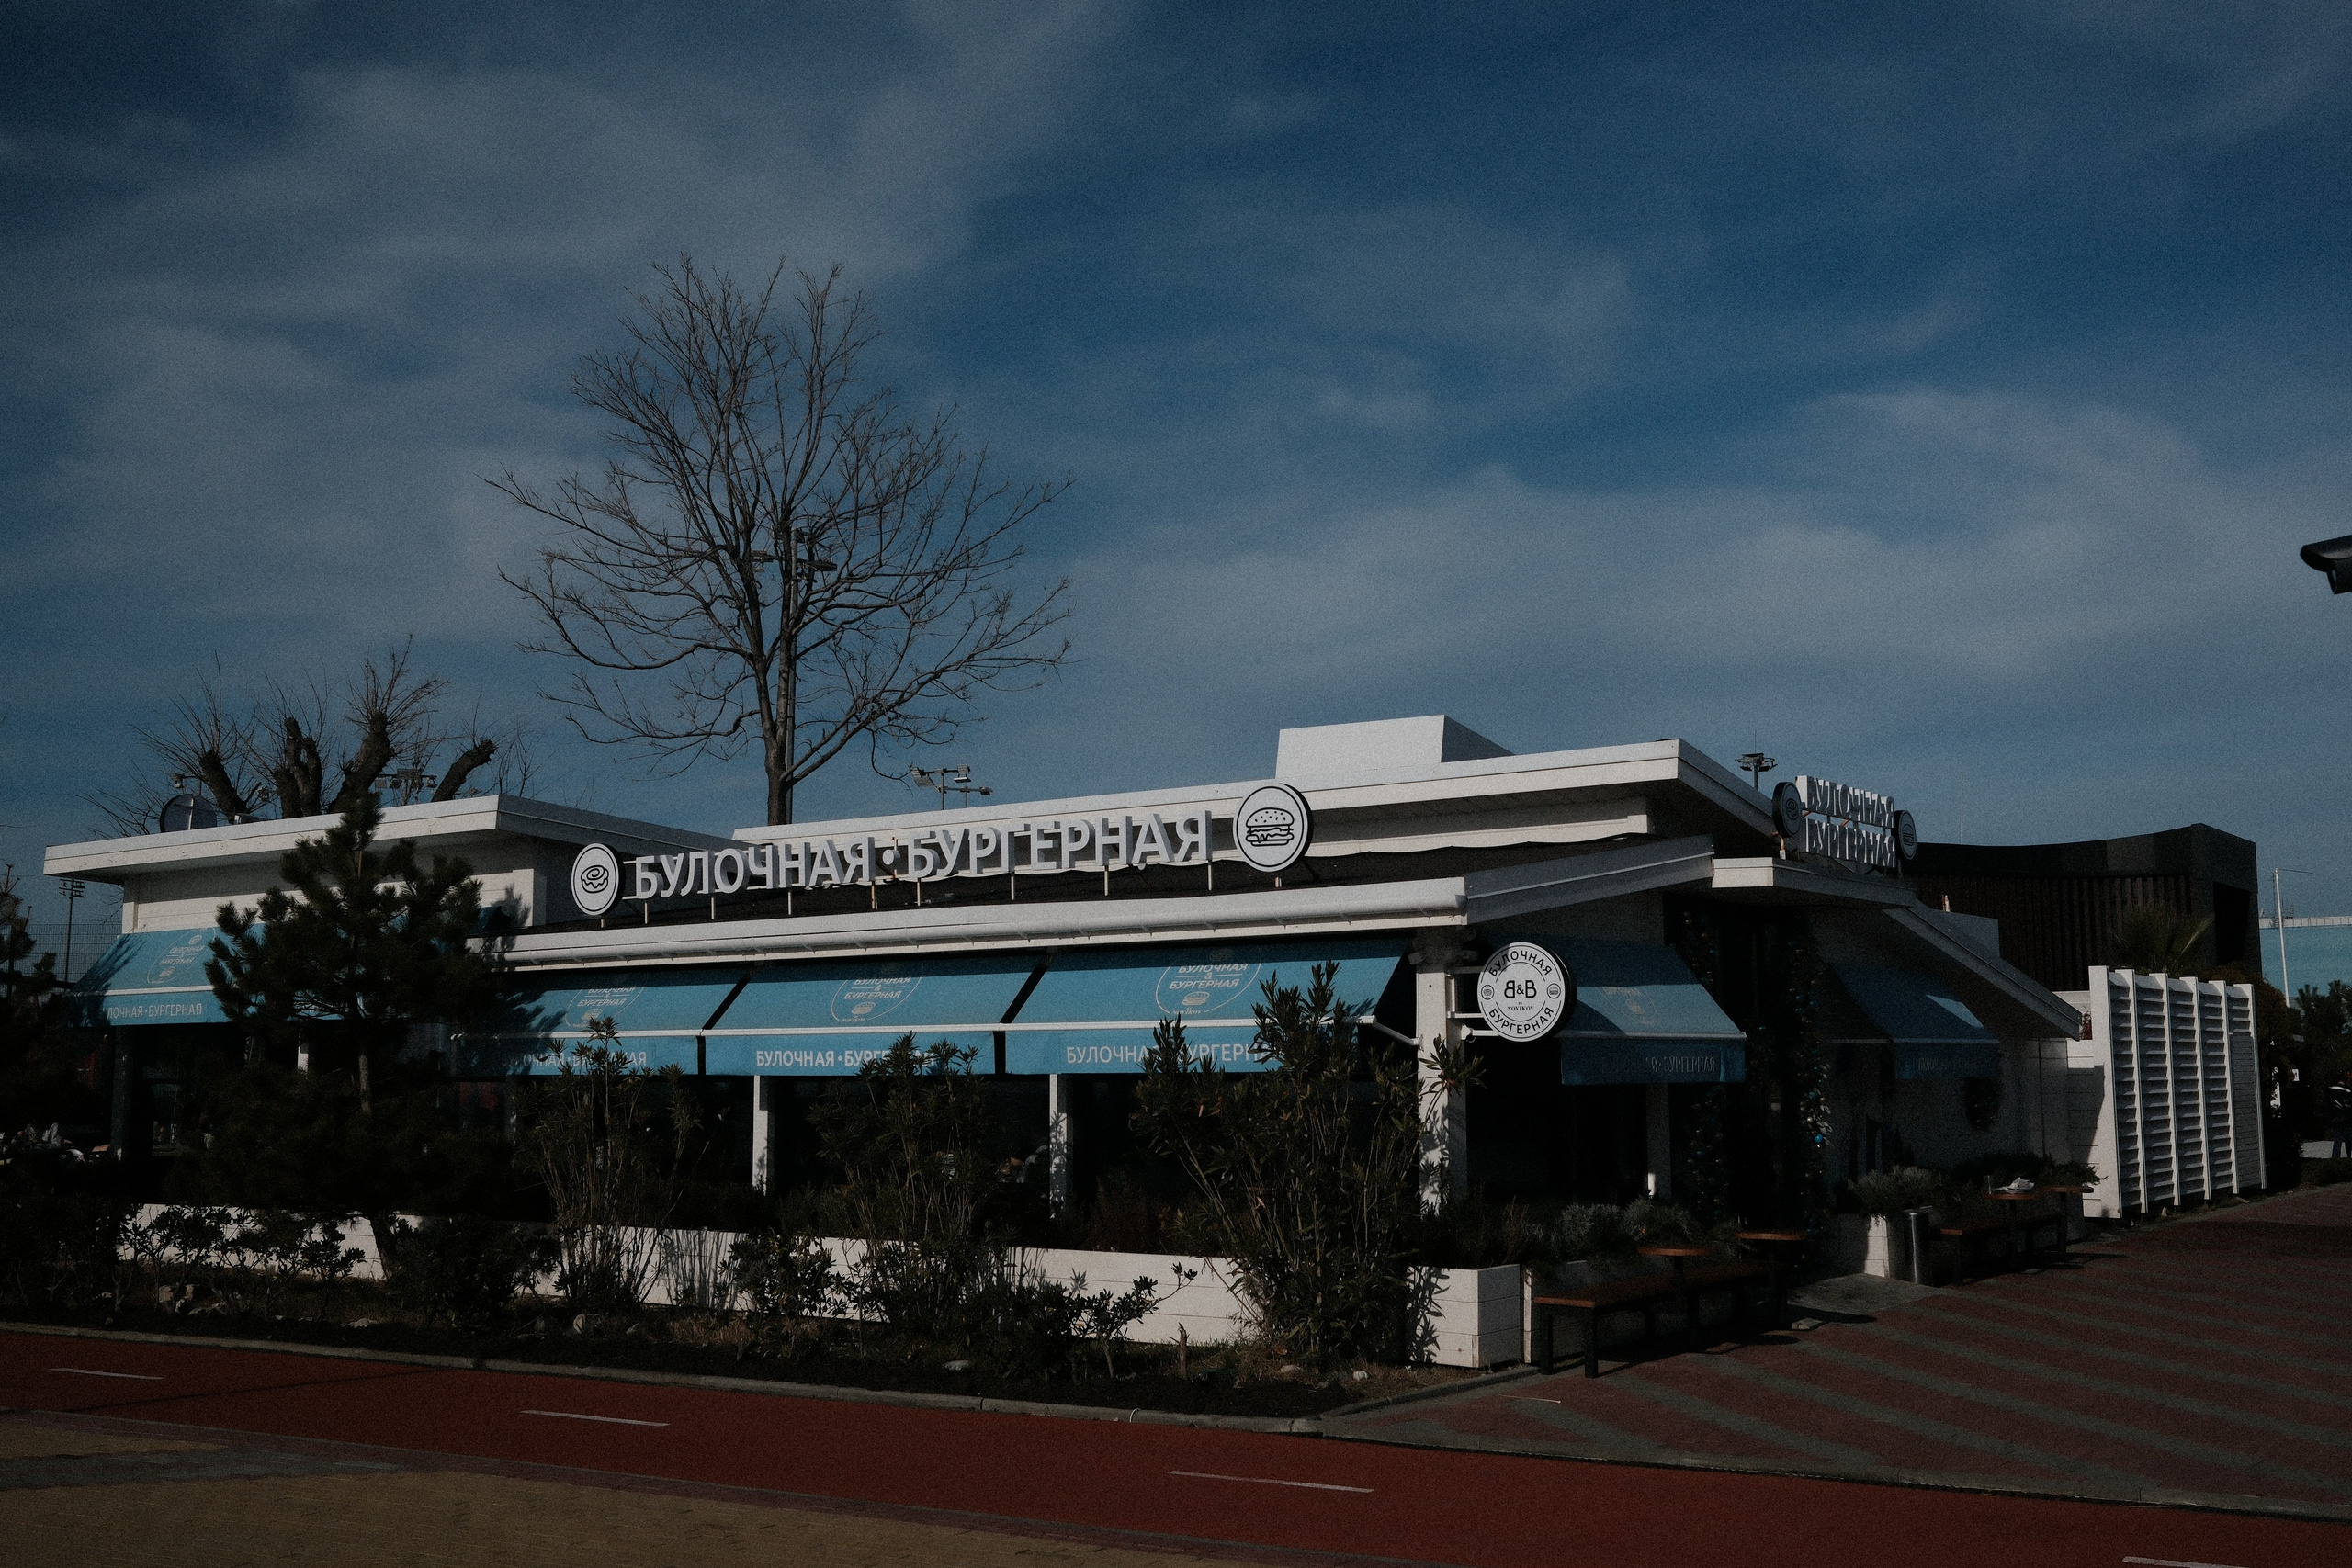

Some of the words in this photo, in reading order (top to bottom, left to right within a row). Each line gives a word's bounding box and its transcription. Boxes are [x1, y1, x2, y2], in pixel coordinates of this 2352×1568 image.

[636, 837, 876, 900] БУЛОЧНАЯ
[908, 811, 1212, 879] БУРГЕРНАЯ
[1178, 964, 1248, 974] БУЛОЧНАЯ
[1488, 950, 1553, 977] БУЛОЧНАЯ
[1169, 979, 1239, 989] БУРГЕРНАЯ
[577, 998, 627, 1007] БУРГЕРНАЯ
[843, 990, 902, 999] БУРГЕРНАЯ
[103, 1006, 143, 1020] ЛОЧНАЯ
[149, 1003, 202, 1017] БУРГЕРНАЯ
[1488, 1007, 1555, 1035] БУРГЕРНАЯ
[755, 1050, 835, 1066] БУЛОЧНАЯ
[1066, 1045, 1159, 1064] БУЛОЧНА
